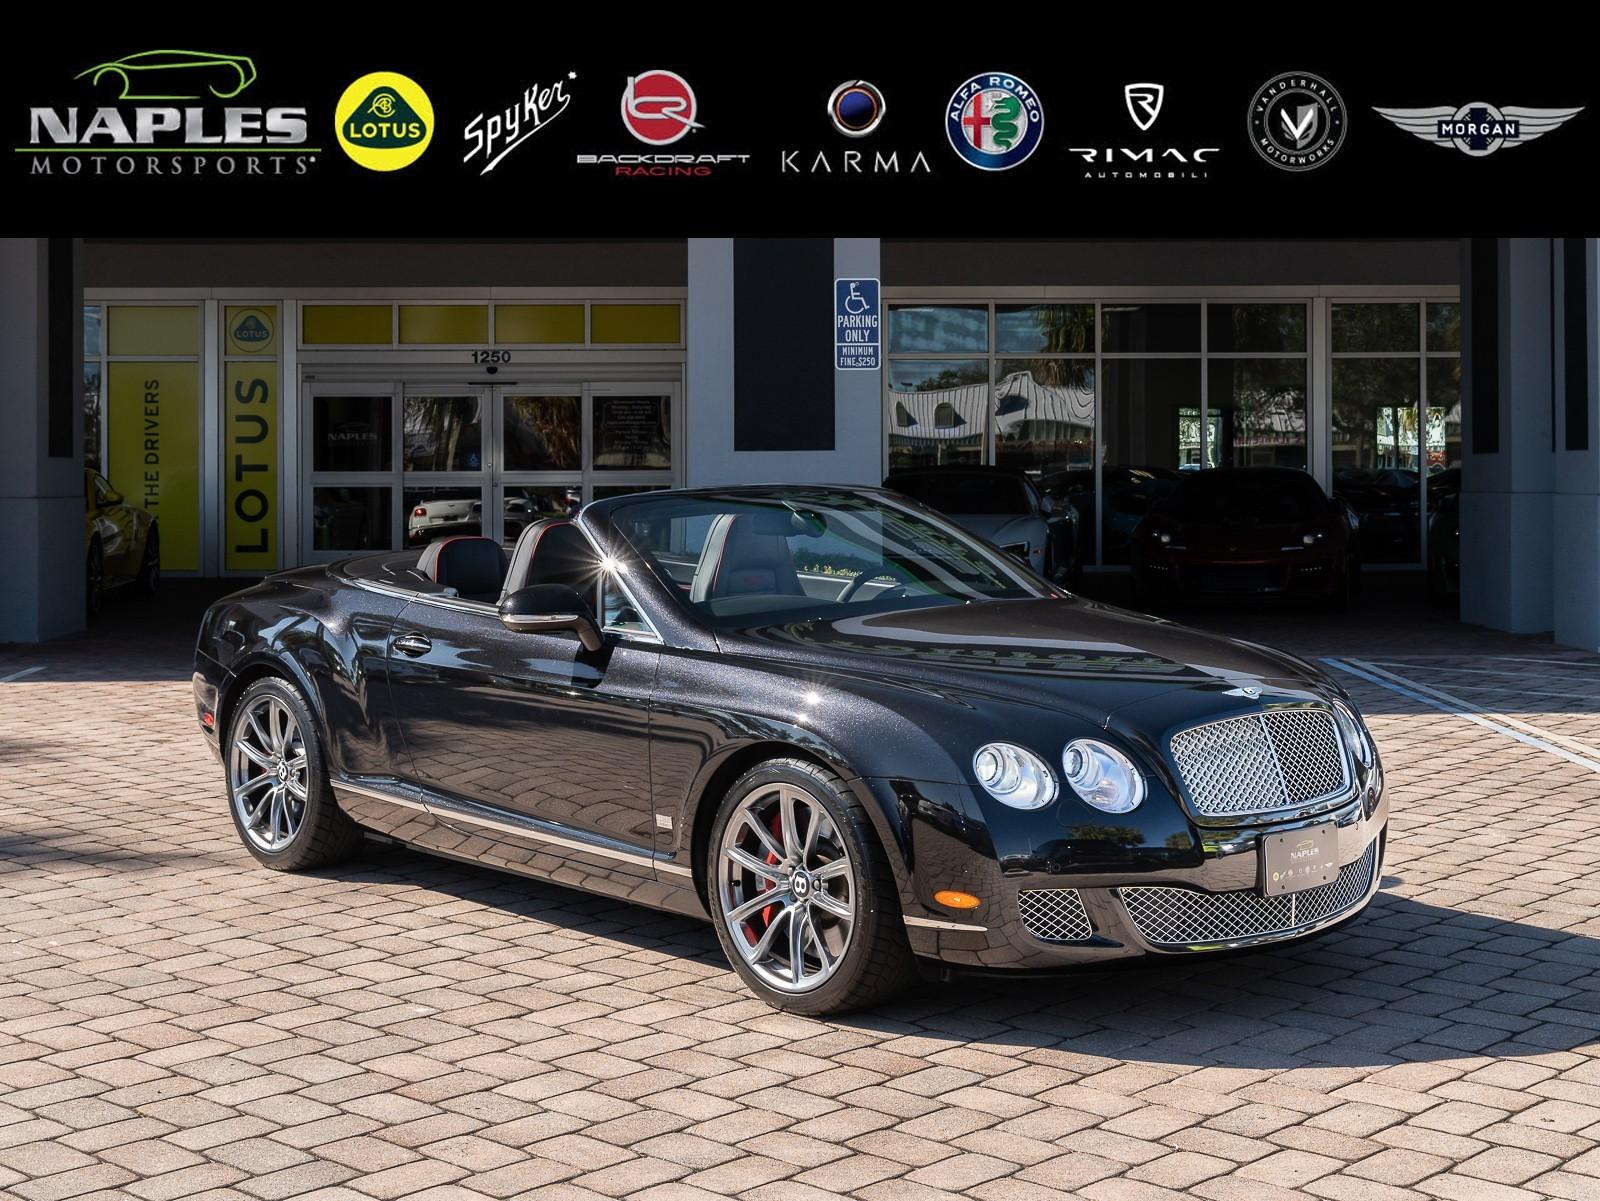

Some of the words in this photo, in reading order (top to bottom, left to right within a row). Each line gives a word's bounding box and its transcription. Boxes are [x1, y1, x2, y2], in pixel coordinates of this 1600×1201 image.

[837, 315, 878, 328] PARKING
[236, 330, 268, 338] LOTUS
[845, 329, 871, 342] ONLY
[471, 351, 511, 364] 1250
[842, 346, 874, 356] MINIMUM
[840, 357, 856, 366] FINE
[858, 357, 876, 367] $250
[144, 379, 160, 465] DRIVERS
[235, 378, 269, 553] LOTUS
[144, 471, 160, 508] THE
